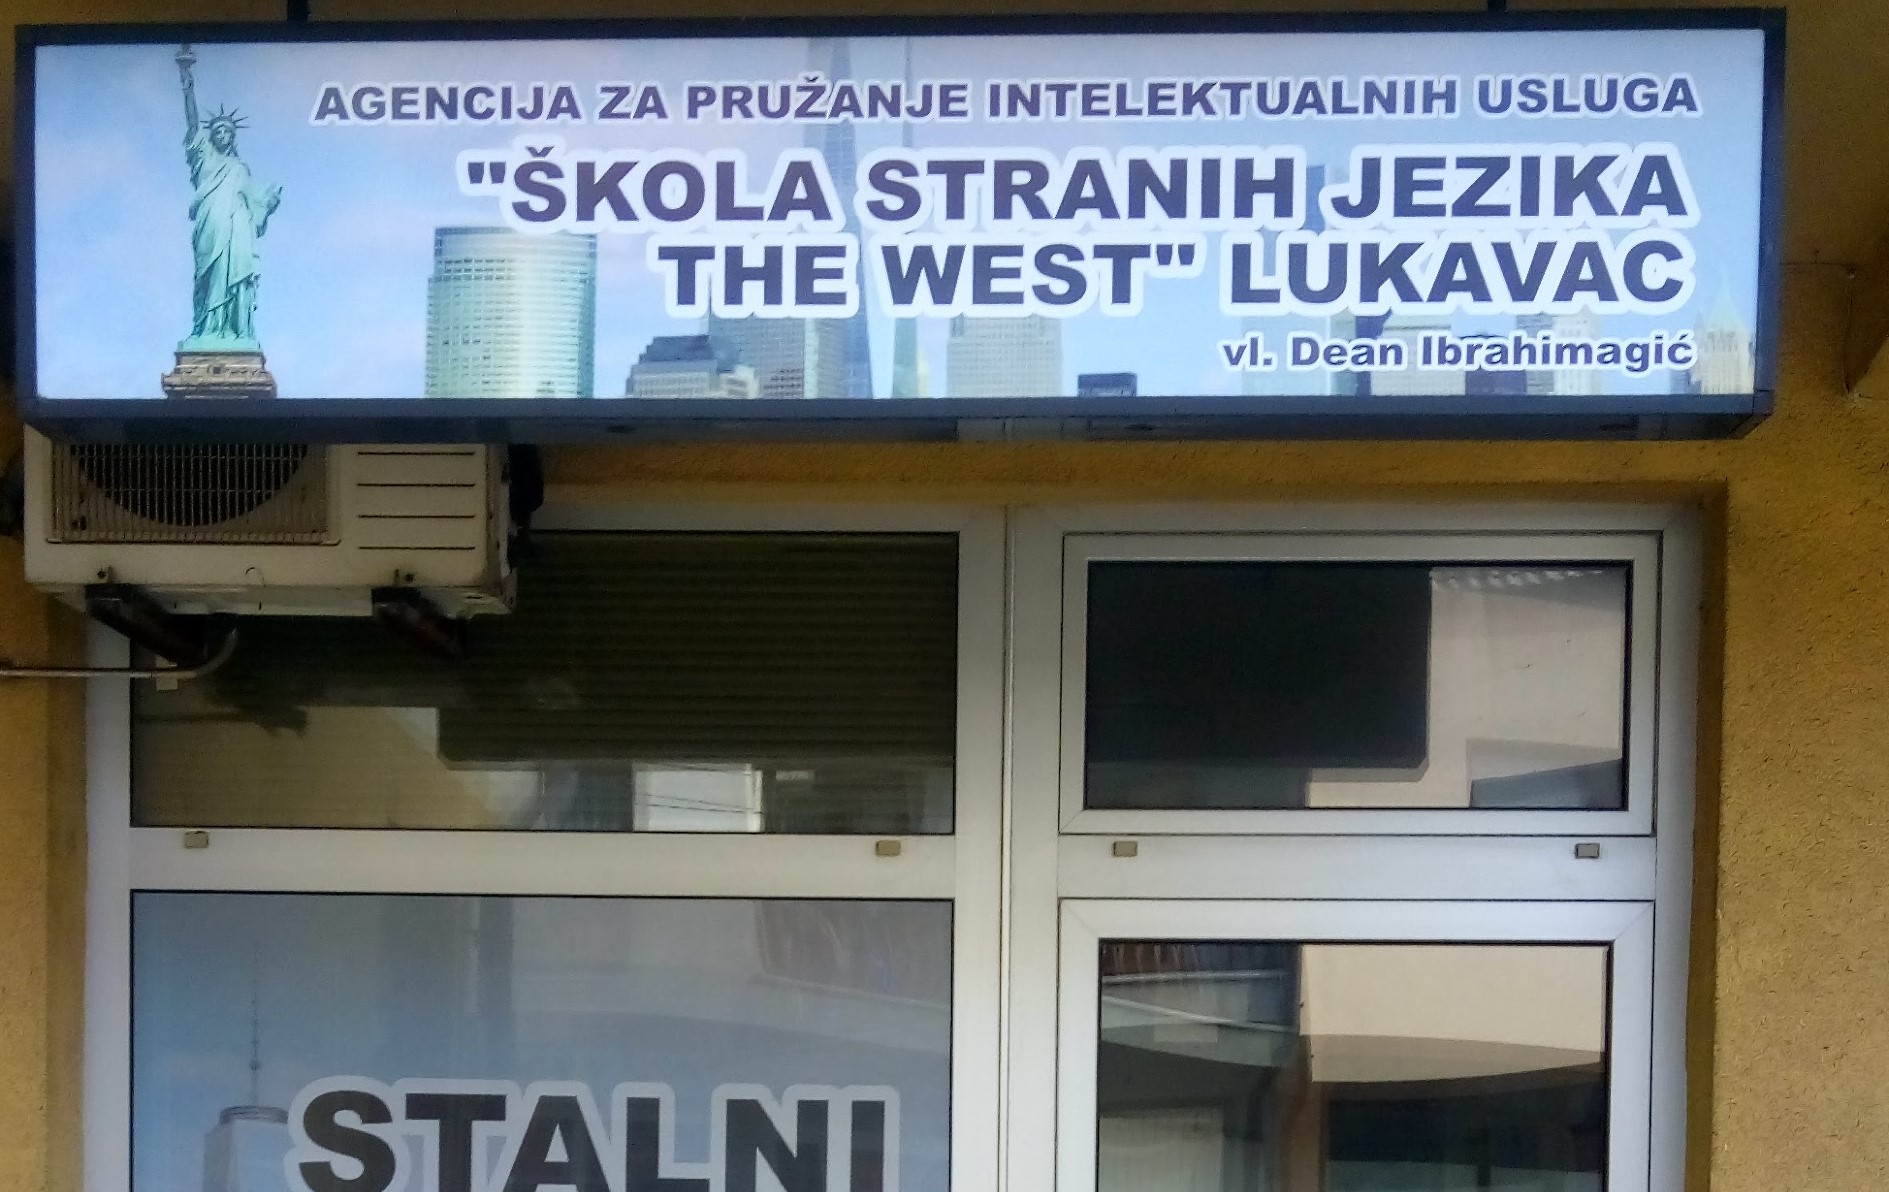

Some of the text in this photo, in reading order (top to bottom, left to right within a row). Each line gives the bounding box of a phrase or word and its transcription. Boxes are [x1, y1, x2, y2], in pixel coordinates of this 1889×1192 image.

[315, 77, 1698, 120] AGENCIJA ZA PRUŽANJE INTELEKTUALNIH USLUGA
[467, 146, 1689, 222] "ŠKOLA STRANIH JEZIKA
[658, 240, 1685, 306] THE WEST" LUKAVAC
[1222, 333, 1695, 373] vl. Dean Ibrahimagić
